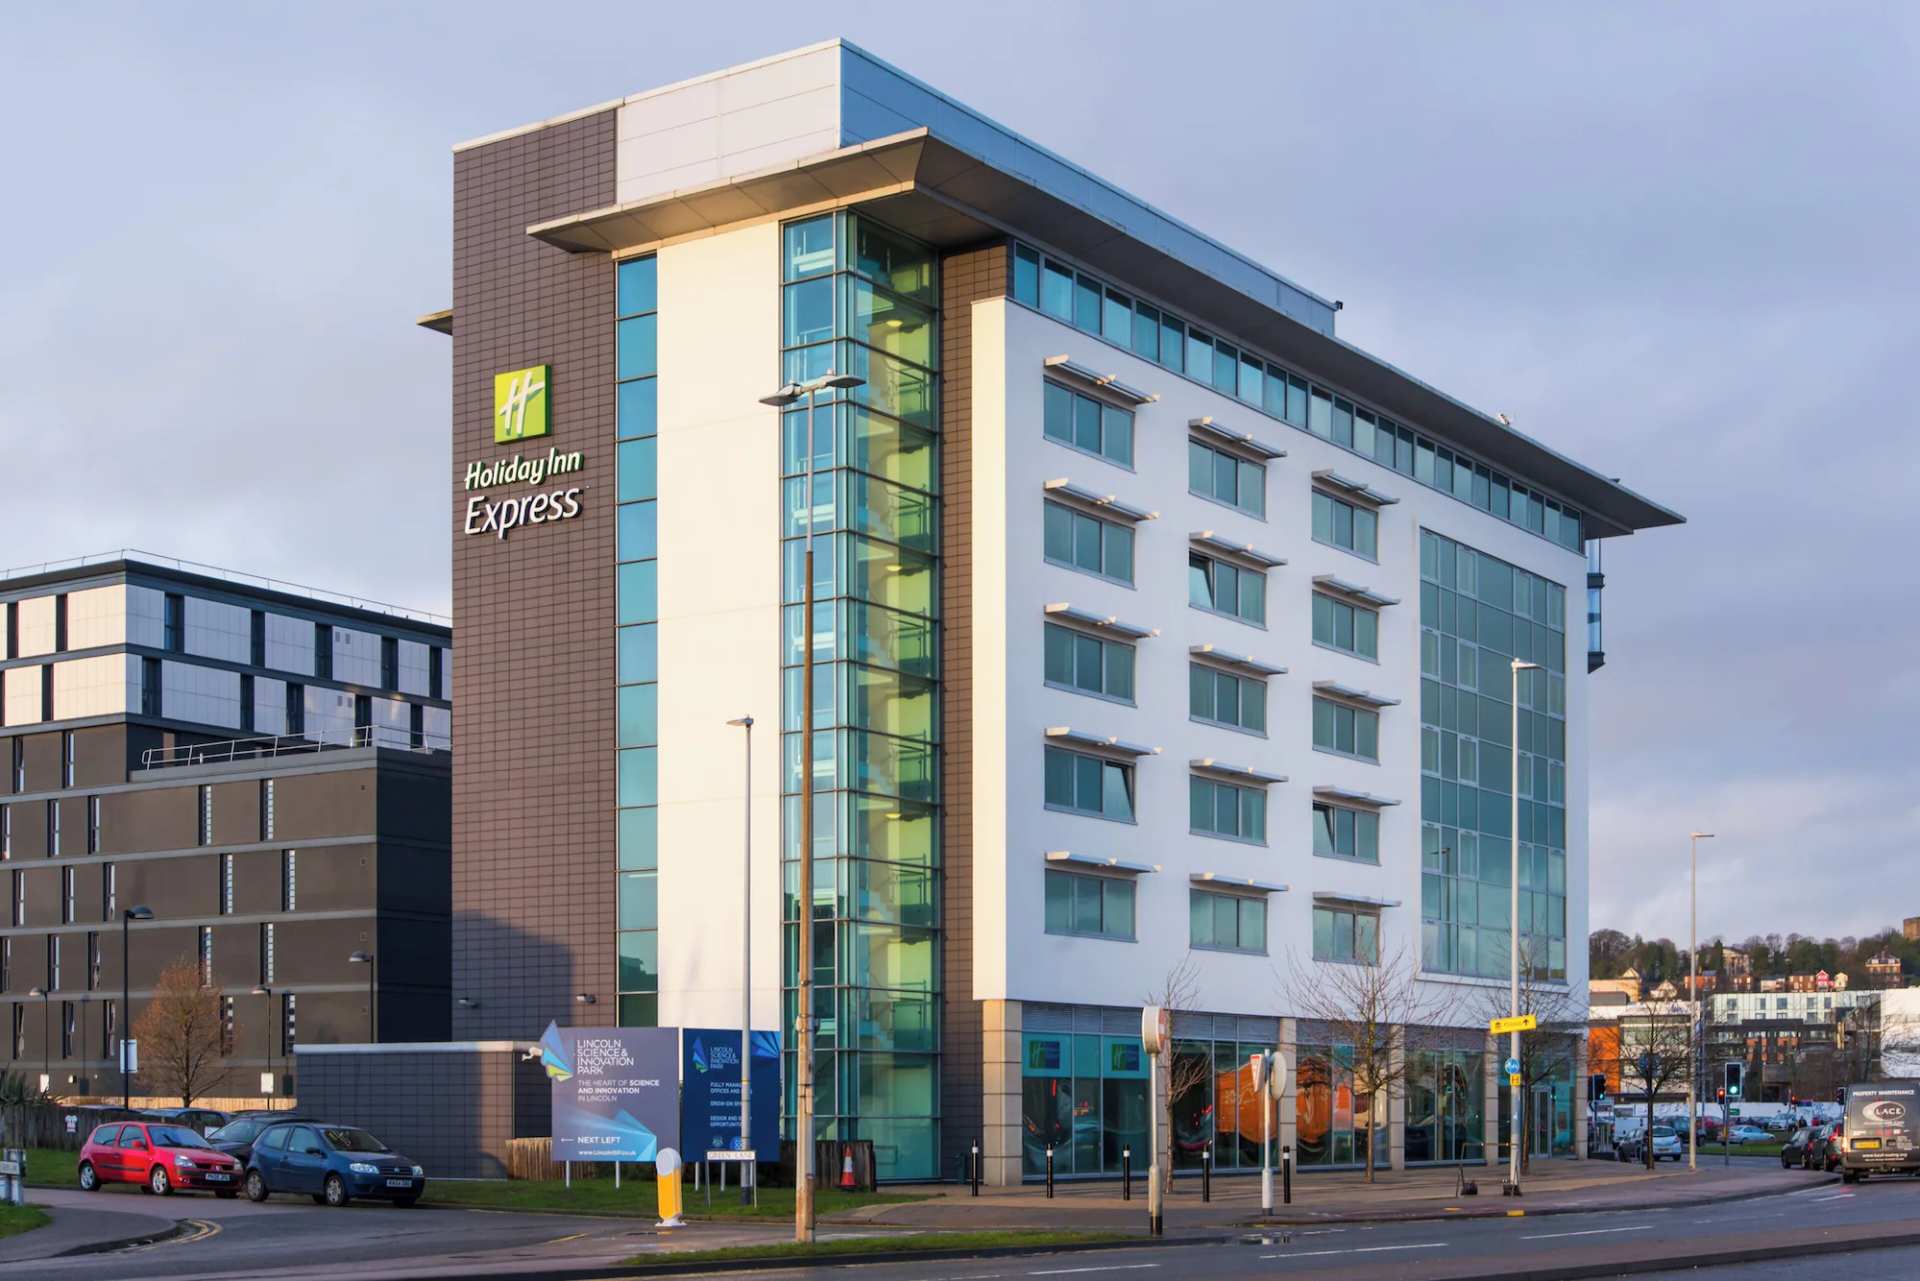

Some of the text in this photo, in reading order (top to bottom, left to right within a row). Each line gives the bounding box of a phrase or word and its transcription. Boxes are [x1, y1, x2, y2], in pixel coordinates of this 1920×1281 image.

[464, 447, 583, 490] Holiday Inn
[464, 487, 582, 539] Express
[577, 1039, 622, 1049] LINCOLN
[577, 1048, 628, 1057] SCIENCE &
[577, 1057, 634, 1066] INNOVATION
[577, 1066, 604, 1075] PARK
[629, 1079, 660, 1087] SCIENCE
[595, 1087, 640, 1095] INNOVATION
[1875, 1107, 1902, 1115] LACE
[577, 1136, 621, 1144] NEXT LEFT
